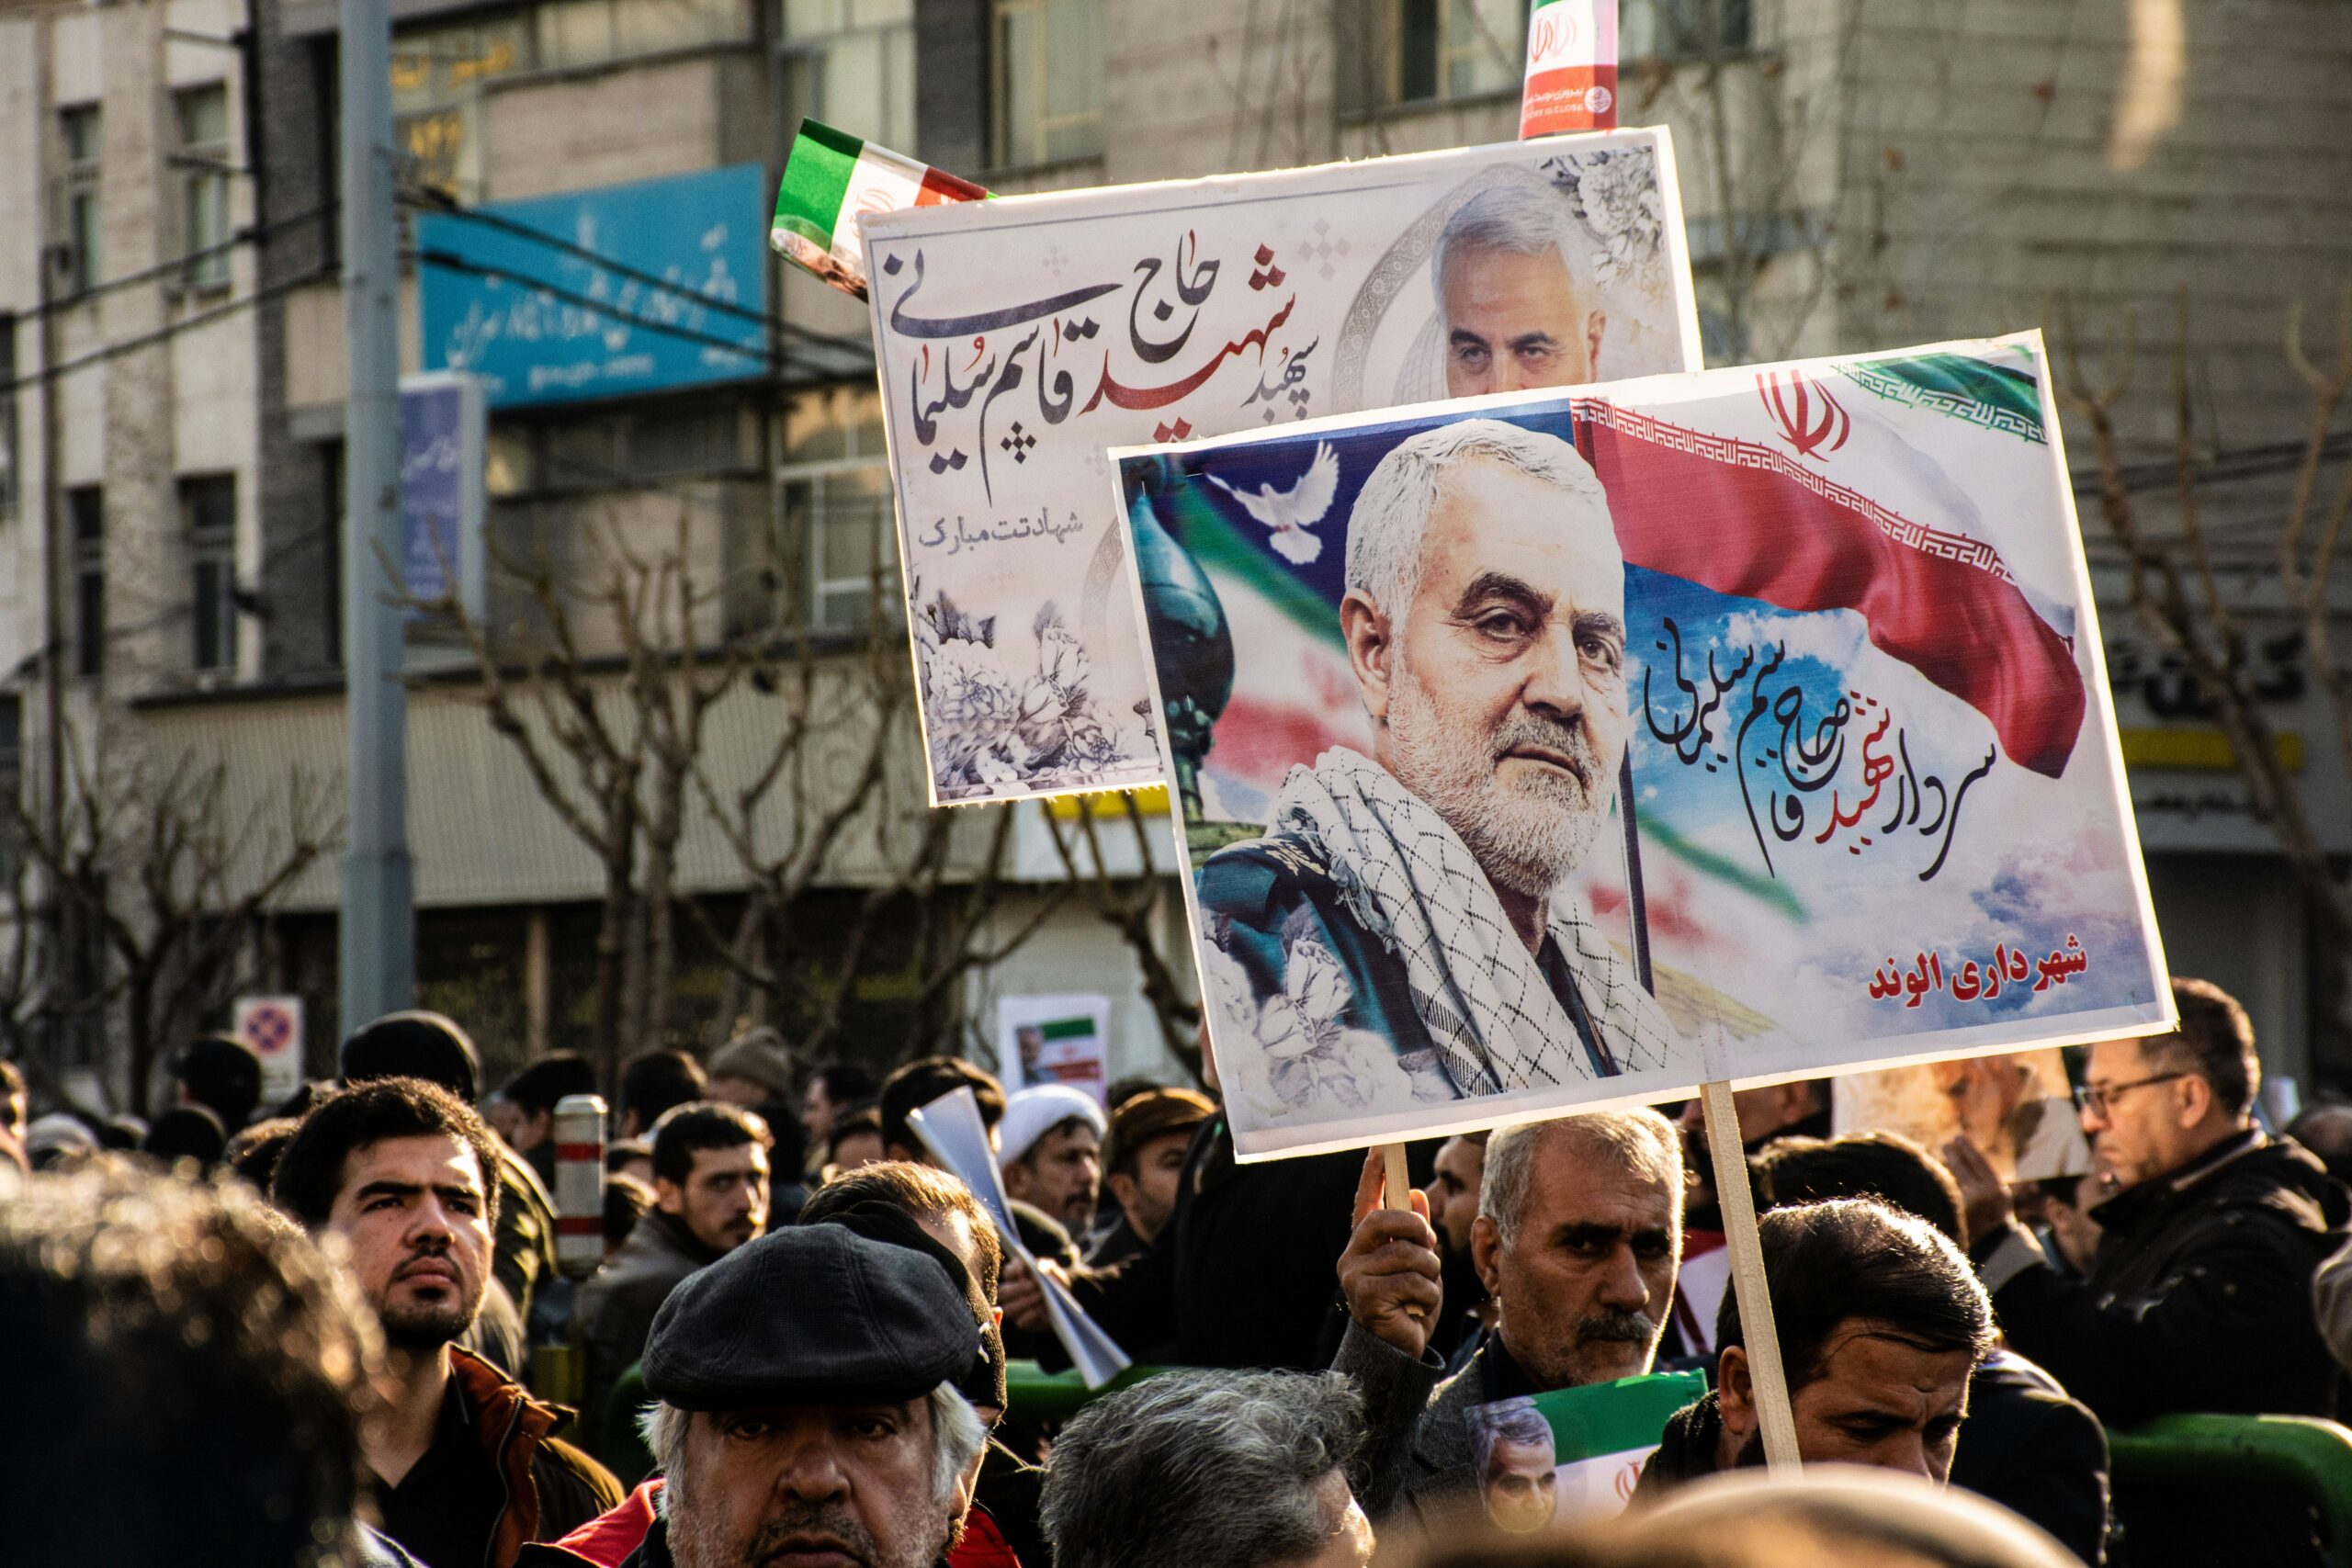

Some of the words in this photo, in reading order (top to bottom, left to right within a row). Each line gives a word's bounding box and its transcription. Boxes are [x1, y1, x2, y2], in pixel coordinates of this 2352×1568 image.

[1076, 243, 1296, 444] شهید
[1129, 228, 1221, 364] حاج
[978, 317, 1101, 509] قاسم
[919, 515, 990, 556] مبارک
[991, 506, 1083, 544] شهادتت
[1643, 616, 1754, 773] سلیمانی
[1736, 638, 1804, 879] قاسم
[1774, 685, 1850, 793] حاج
[1815, 689, 1895, 855] شهید
[1881, 727, 1996, 882] سردار
[1869, 950, 1943, 1009] الوند
[1951, 933, 2087, 1002] شهرداری
